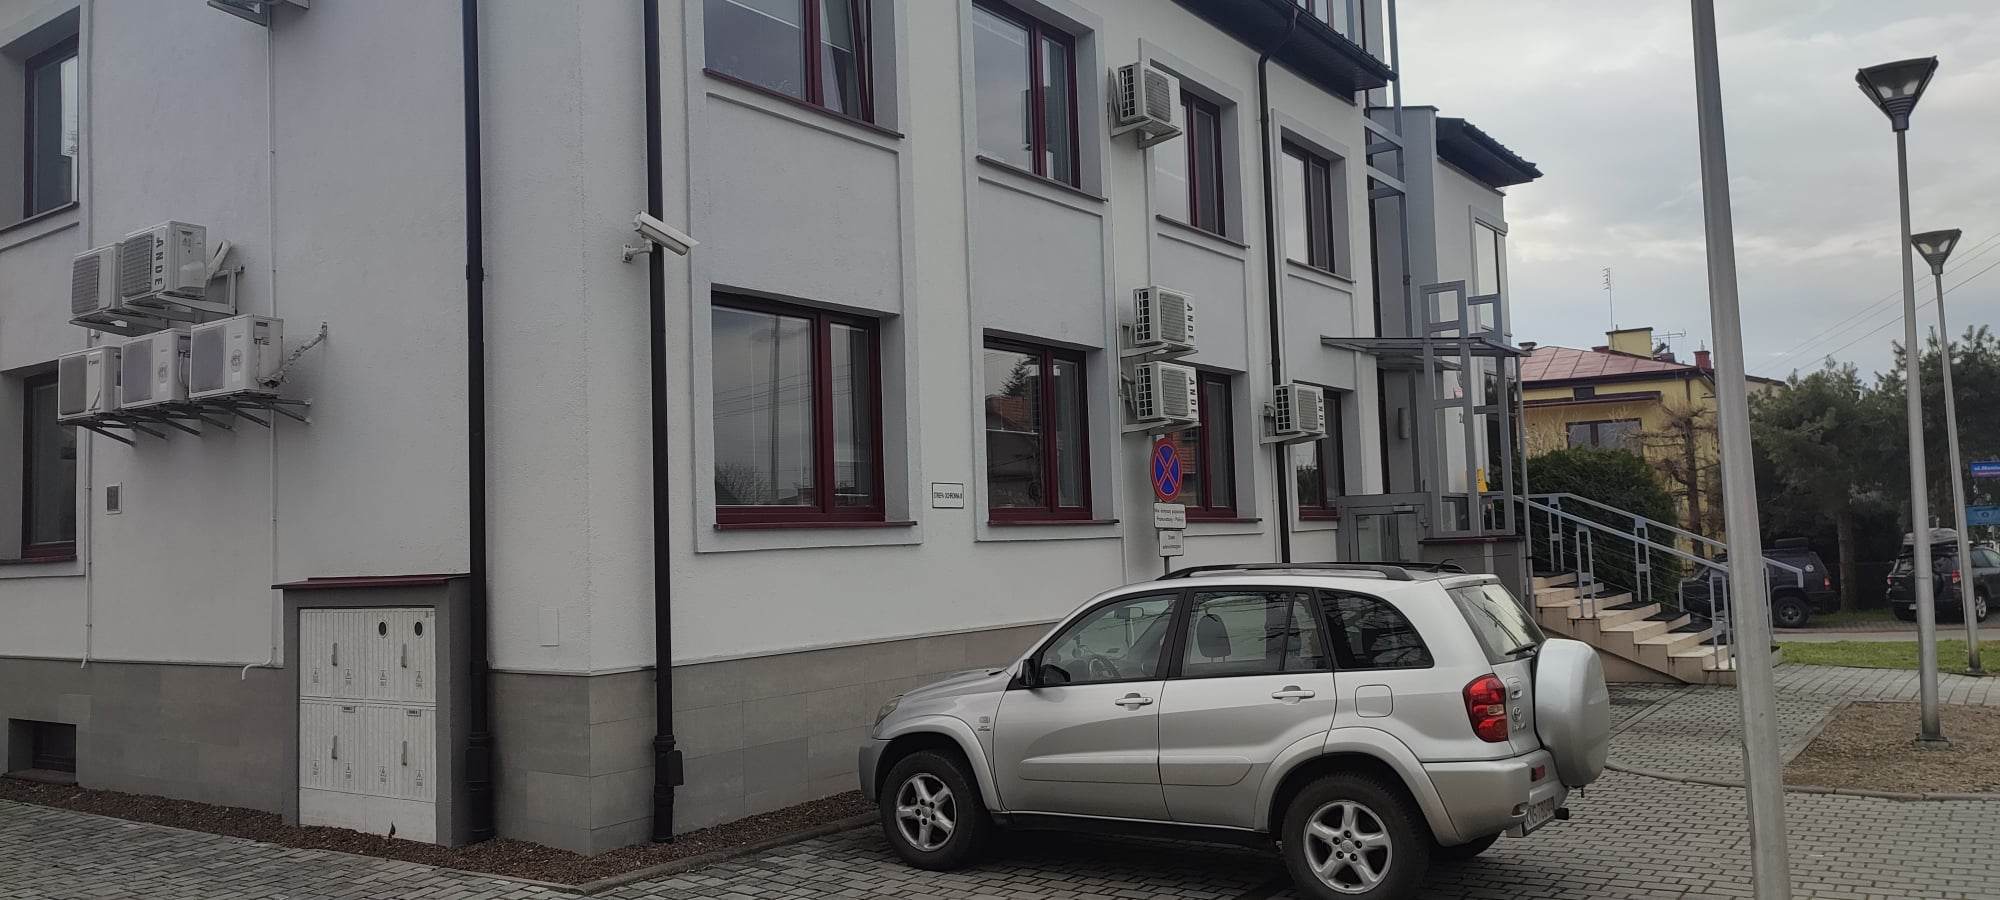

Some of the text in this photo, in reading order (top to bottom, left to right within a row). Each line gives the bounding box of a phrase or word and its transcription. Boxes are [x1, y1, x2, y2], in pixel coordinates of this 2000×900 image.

[154, 236, 164, 286] ANDE
[1187, 303, 1195, 341] ANDE
[1189, 376, 1197, 414] ANDE
